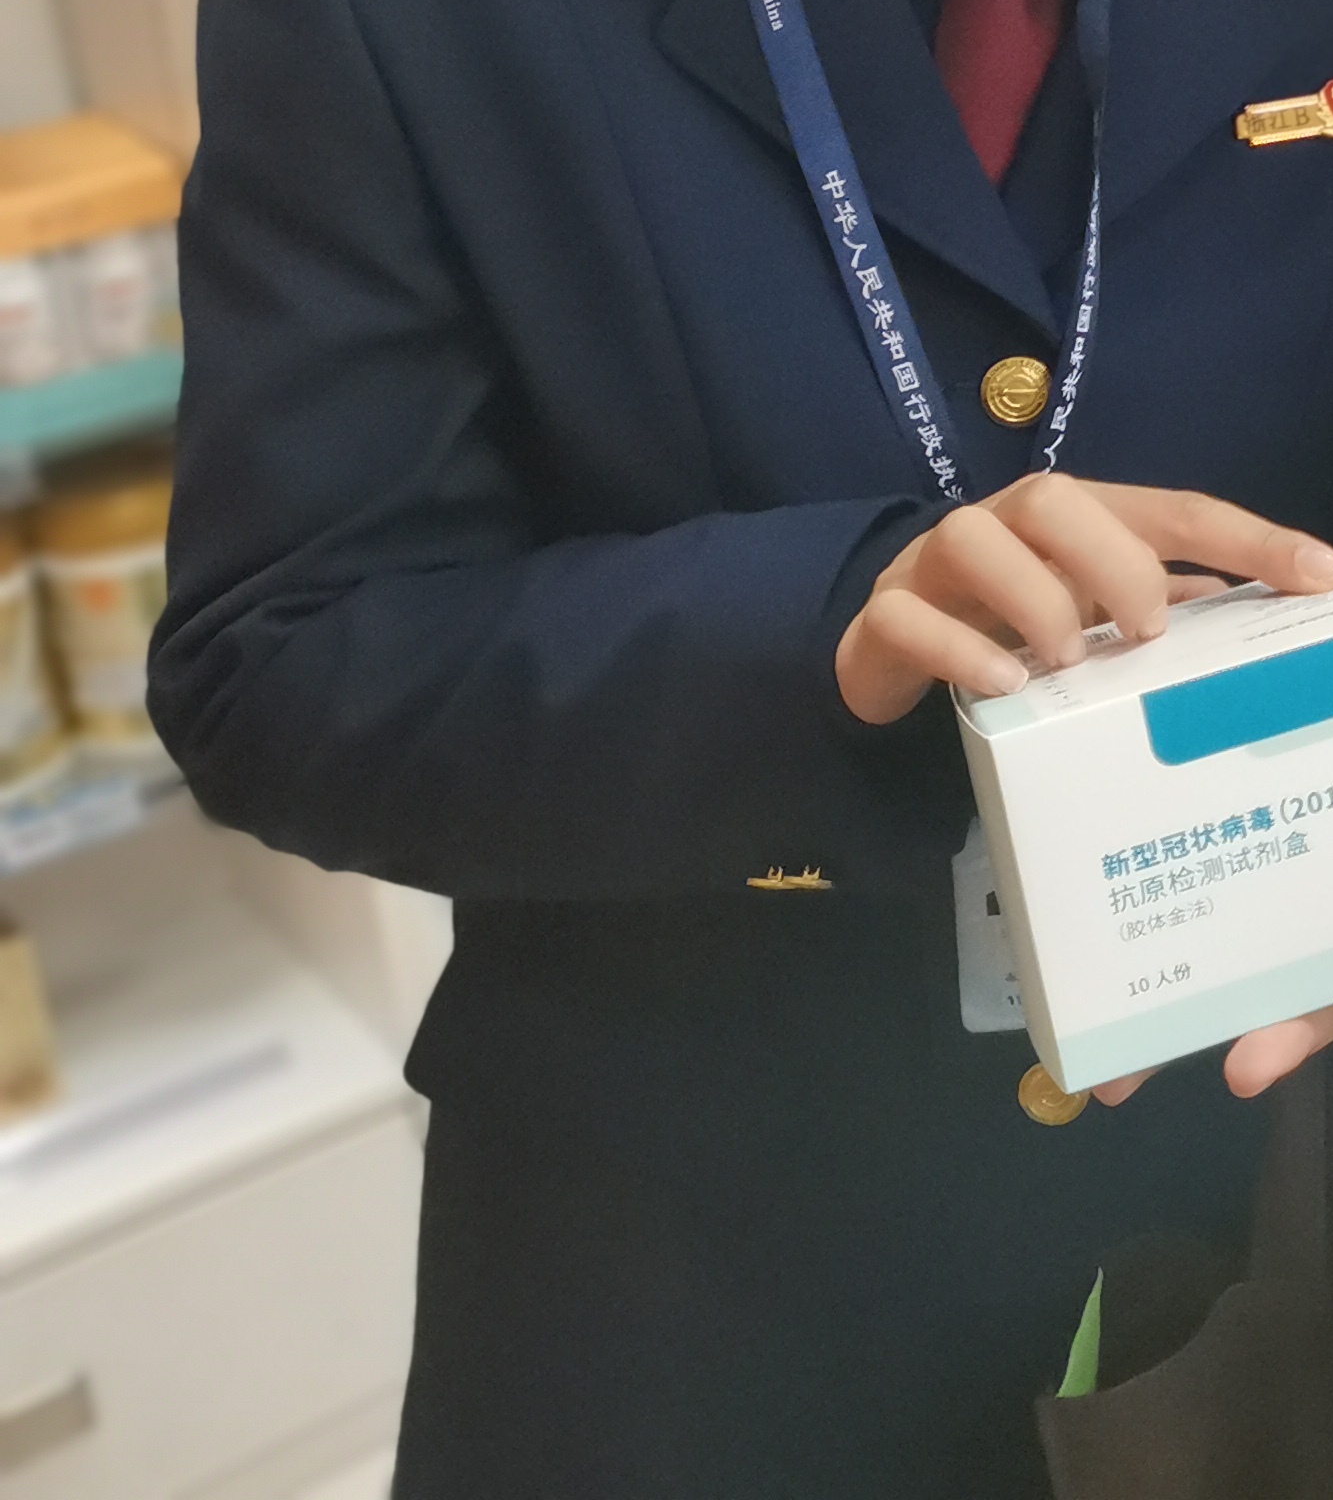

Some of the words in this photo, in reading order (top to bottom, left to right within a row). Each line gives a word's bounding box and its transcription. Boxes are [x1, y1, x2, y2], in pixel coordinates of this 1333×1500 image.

[1108, 830, 1311, 915] 抗原检测试剂盒
